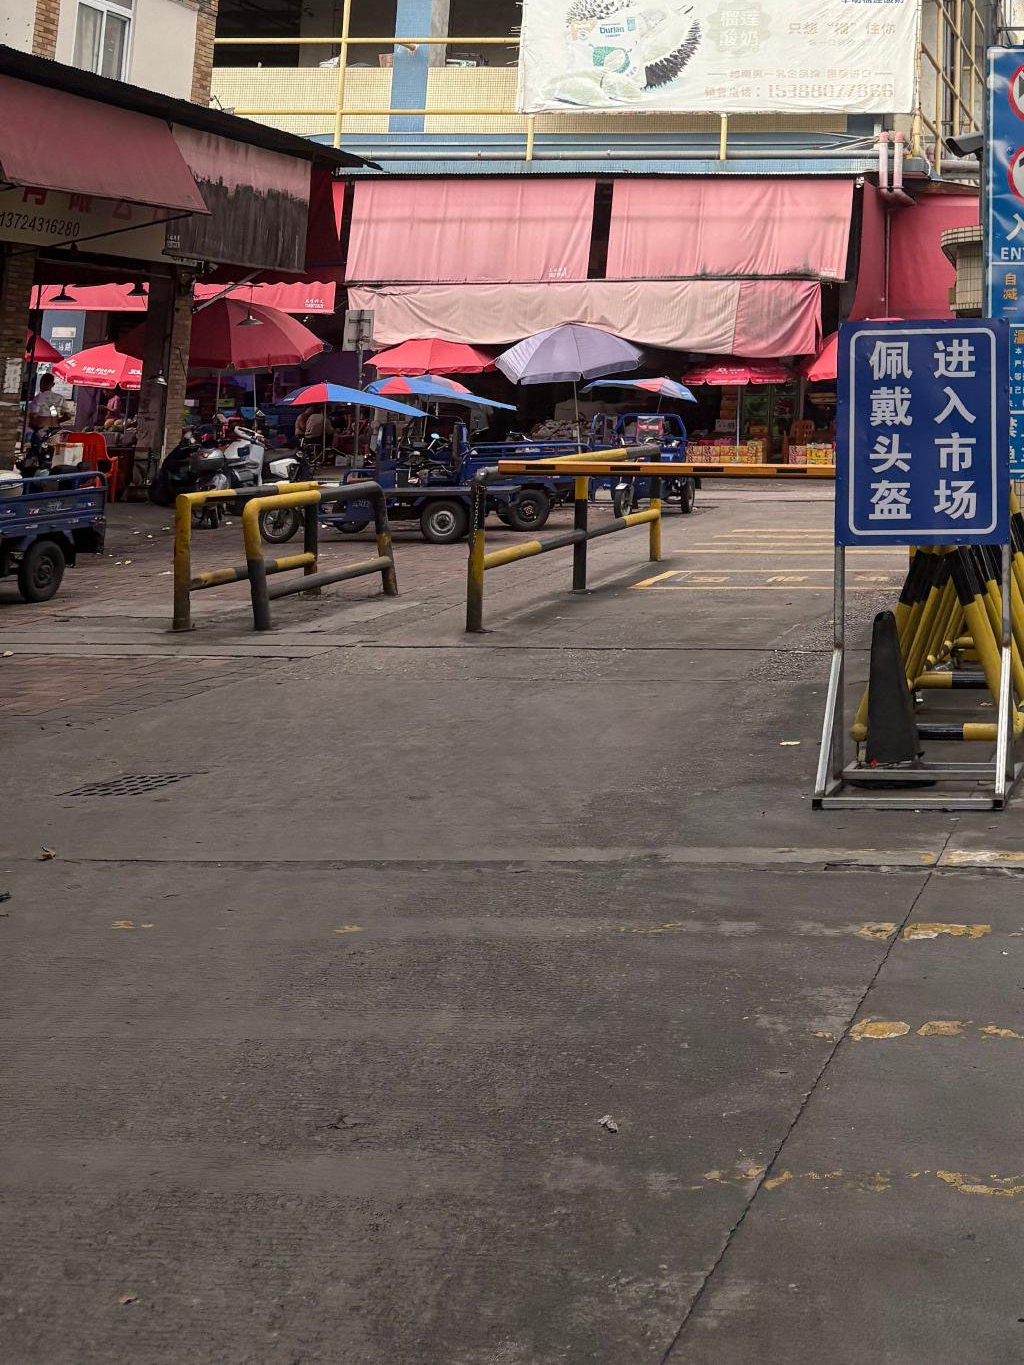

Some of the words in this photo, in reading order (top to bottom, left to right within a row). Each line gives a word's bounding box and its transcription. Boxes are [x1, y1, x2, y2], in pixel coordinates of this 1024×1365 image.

[599, 26, 625, 34] Durian
[868, 340, 913, 520] 佩戴头盔
[933, 339, 977, 520] 进入市场
